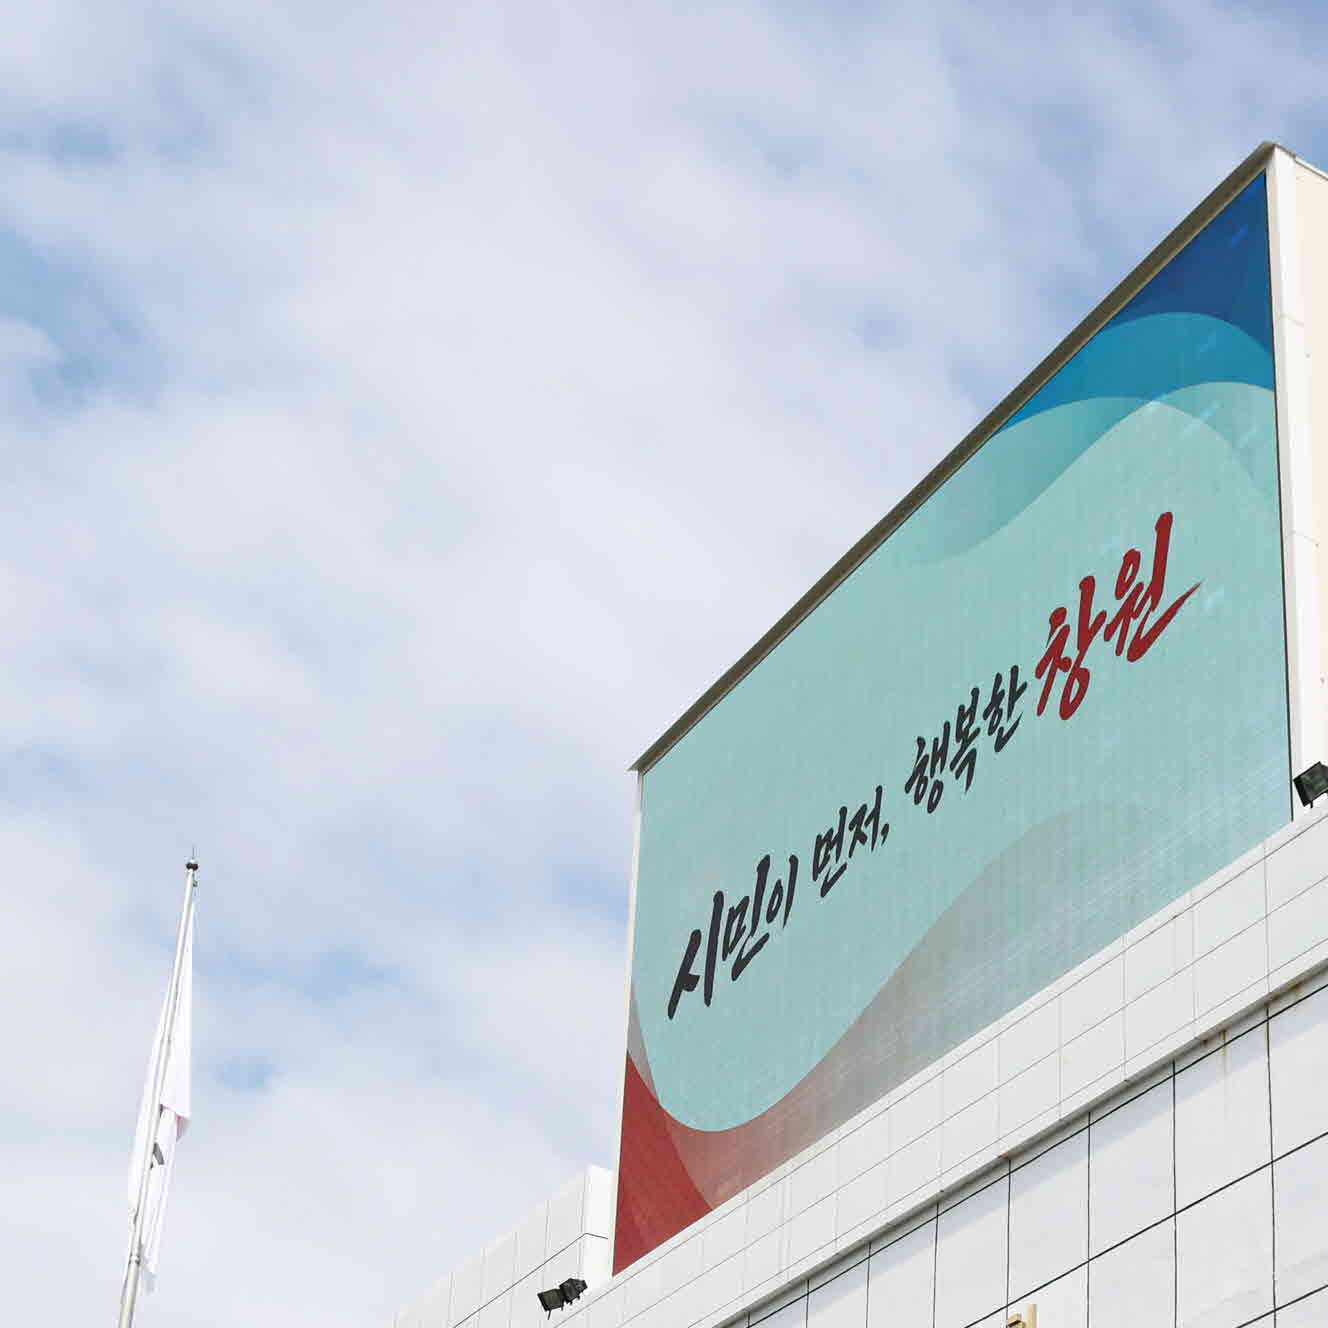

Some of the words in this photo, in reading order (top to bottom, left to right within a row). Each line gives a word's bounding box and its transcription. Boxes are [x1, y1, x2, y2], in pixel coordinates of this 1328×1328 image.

[667, 853, 798, 1020] 시민이
[813, 785, 890, 898] 먼저,
[904, 665, 1026, 814] 행복한
[1036, 511, 1205, 721] 창원
